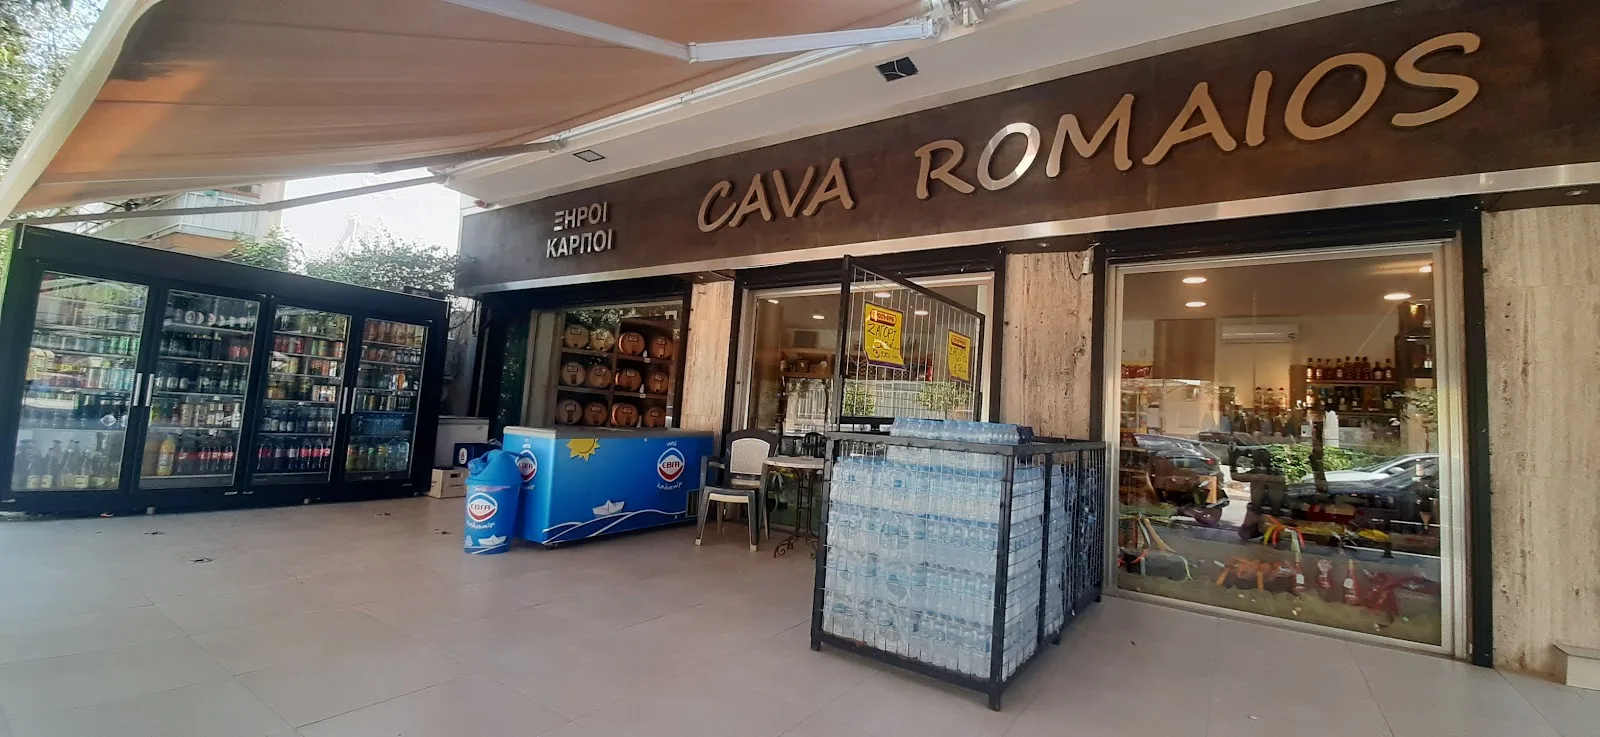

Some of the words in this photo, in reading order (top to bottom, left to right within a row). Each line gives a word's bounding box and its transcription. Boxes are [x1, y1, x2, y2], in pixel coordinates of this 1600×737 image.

[698, 157, 854, 234] CAVA
[915, 31, 1482, 202] ROMAIOS
[553, 202, 608, 232] ΞΗΡΟΙ
[545, 228, 613, 259] ΚΑΡΠΟΙ
